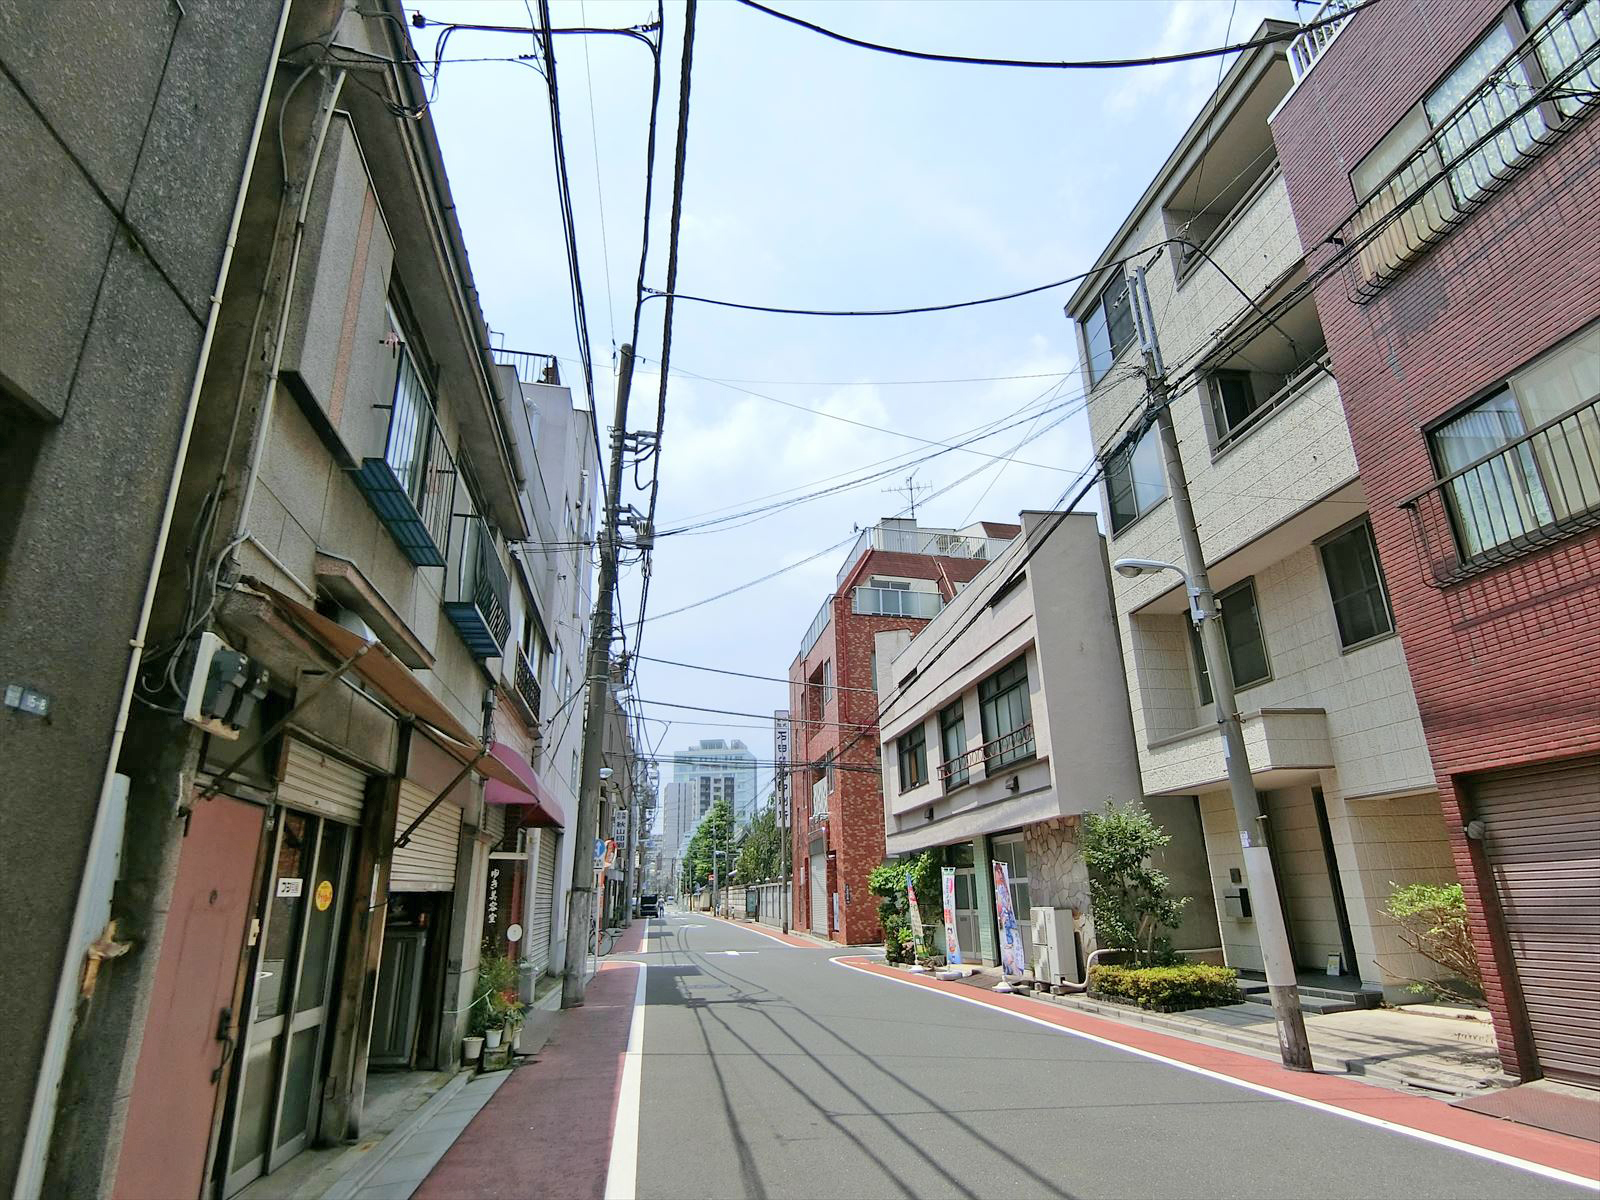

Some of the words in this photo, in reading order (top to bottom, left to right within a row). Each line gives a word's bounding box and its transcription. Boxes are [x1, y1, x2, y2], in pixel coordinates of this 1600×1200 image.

[488, 868, 500, 924] ゆき美容室
